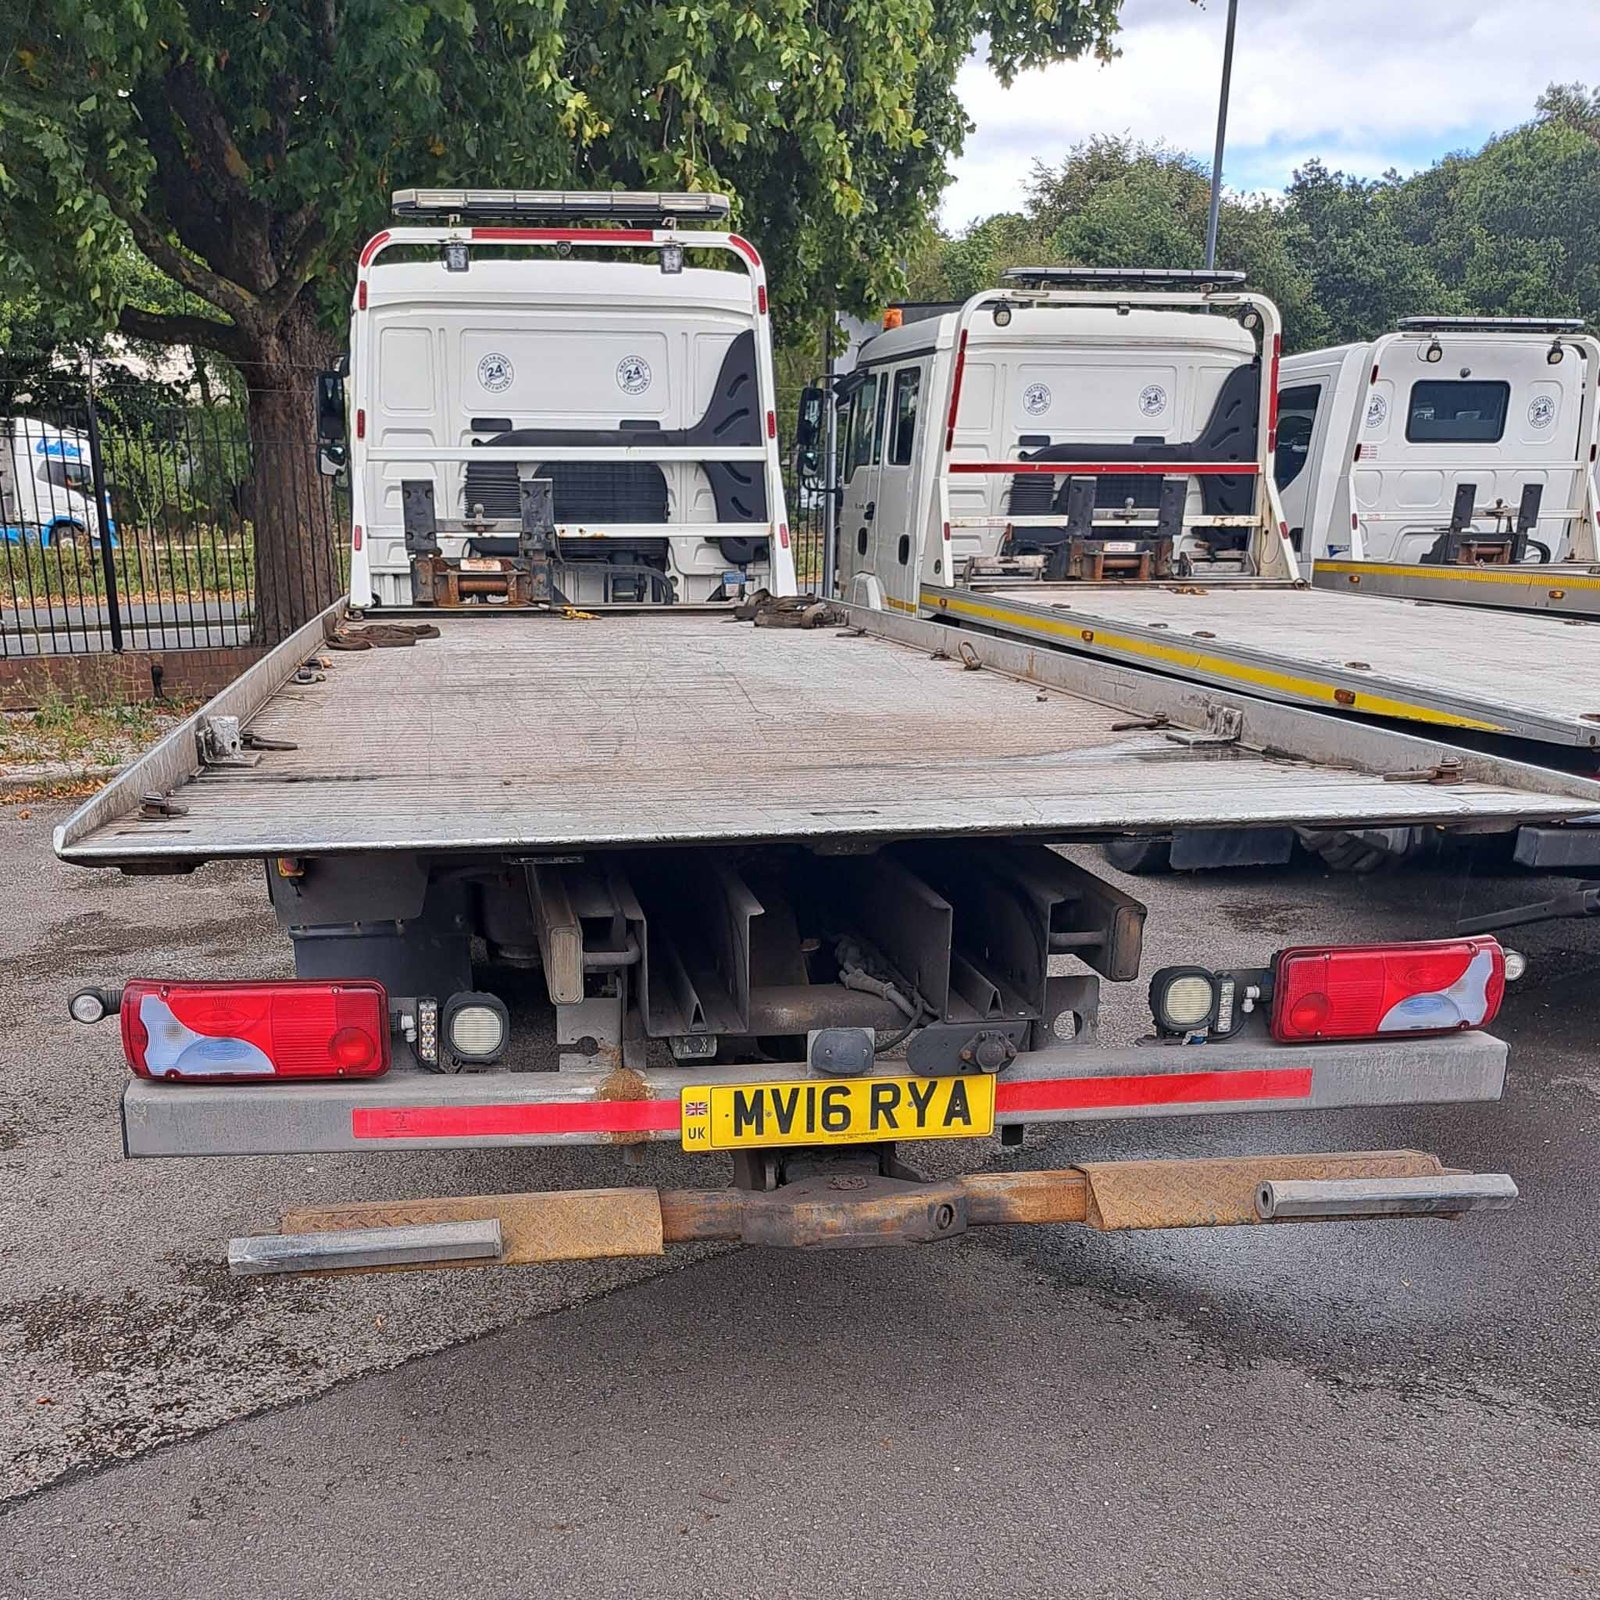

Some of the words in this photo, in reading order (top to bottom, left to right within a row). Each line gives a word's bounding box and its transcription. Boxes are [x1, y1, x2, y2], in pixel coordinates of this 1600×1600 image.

[487, 364, 503, 377] 24
[625, 366, 640, 379] 24
[733, 1085, 852, 1137] MV16
[869, 1079, 973, 1130] RYA
[688, 1126, 706, 1140] UK
